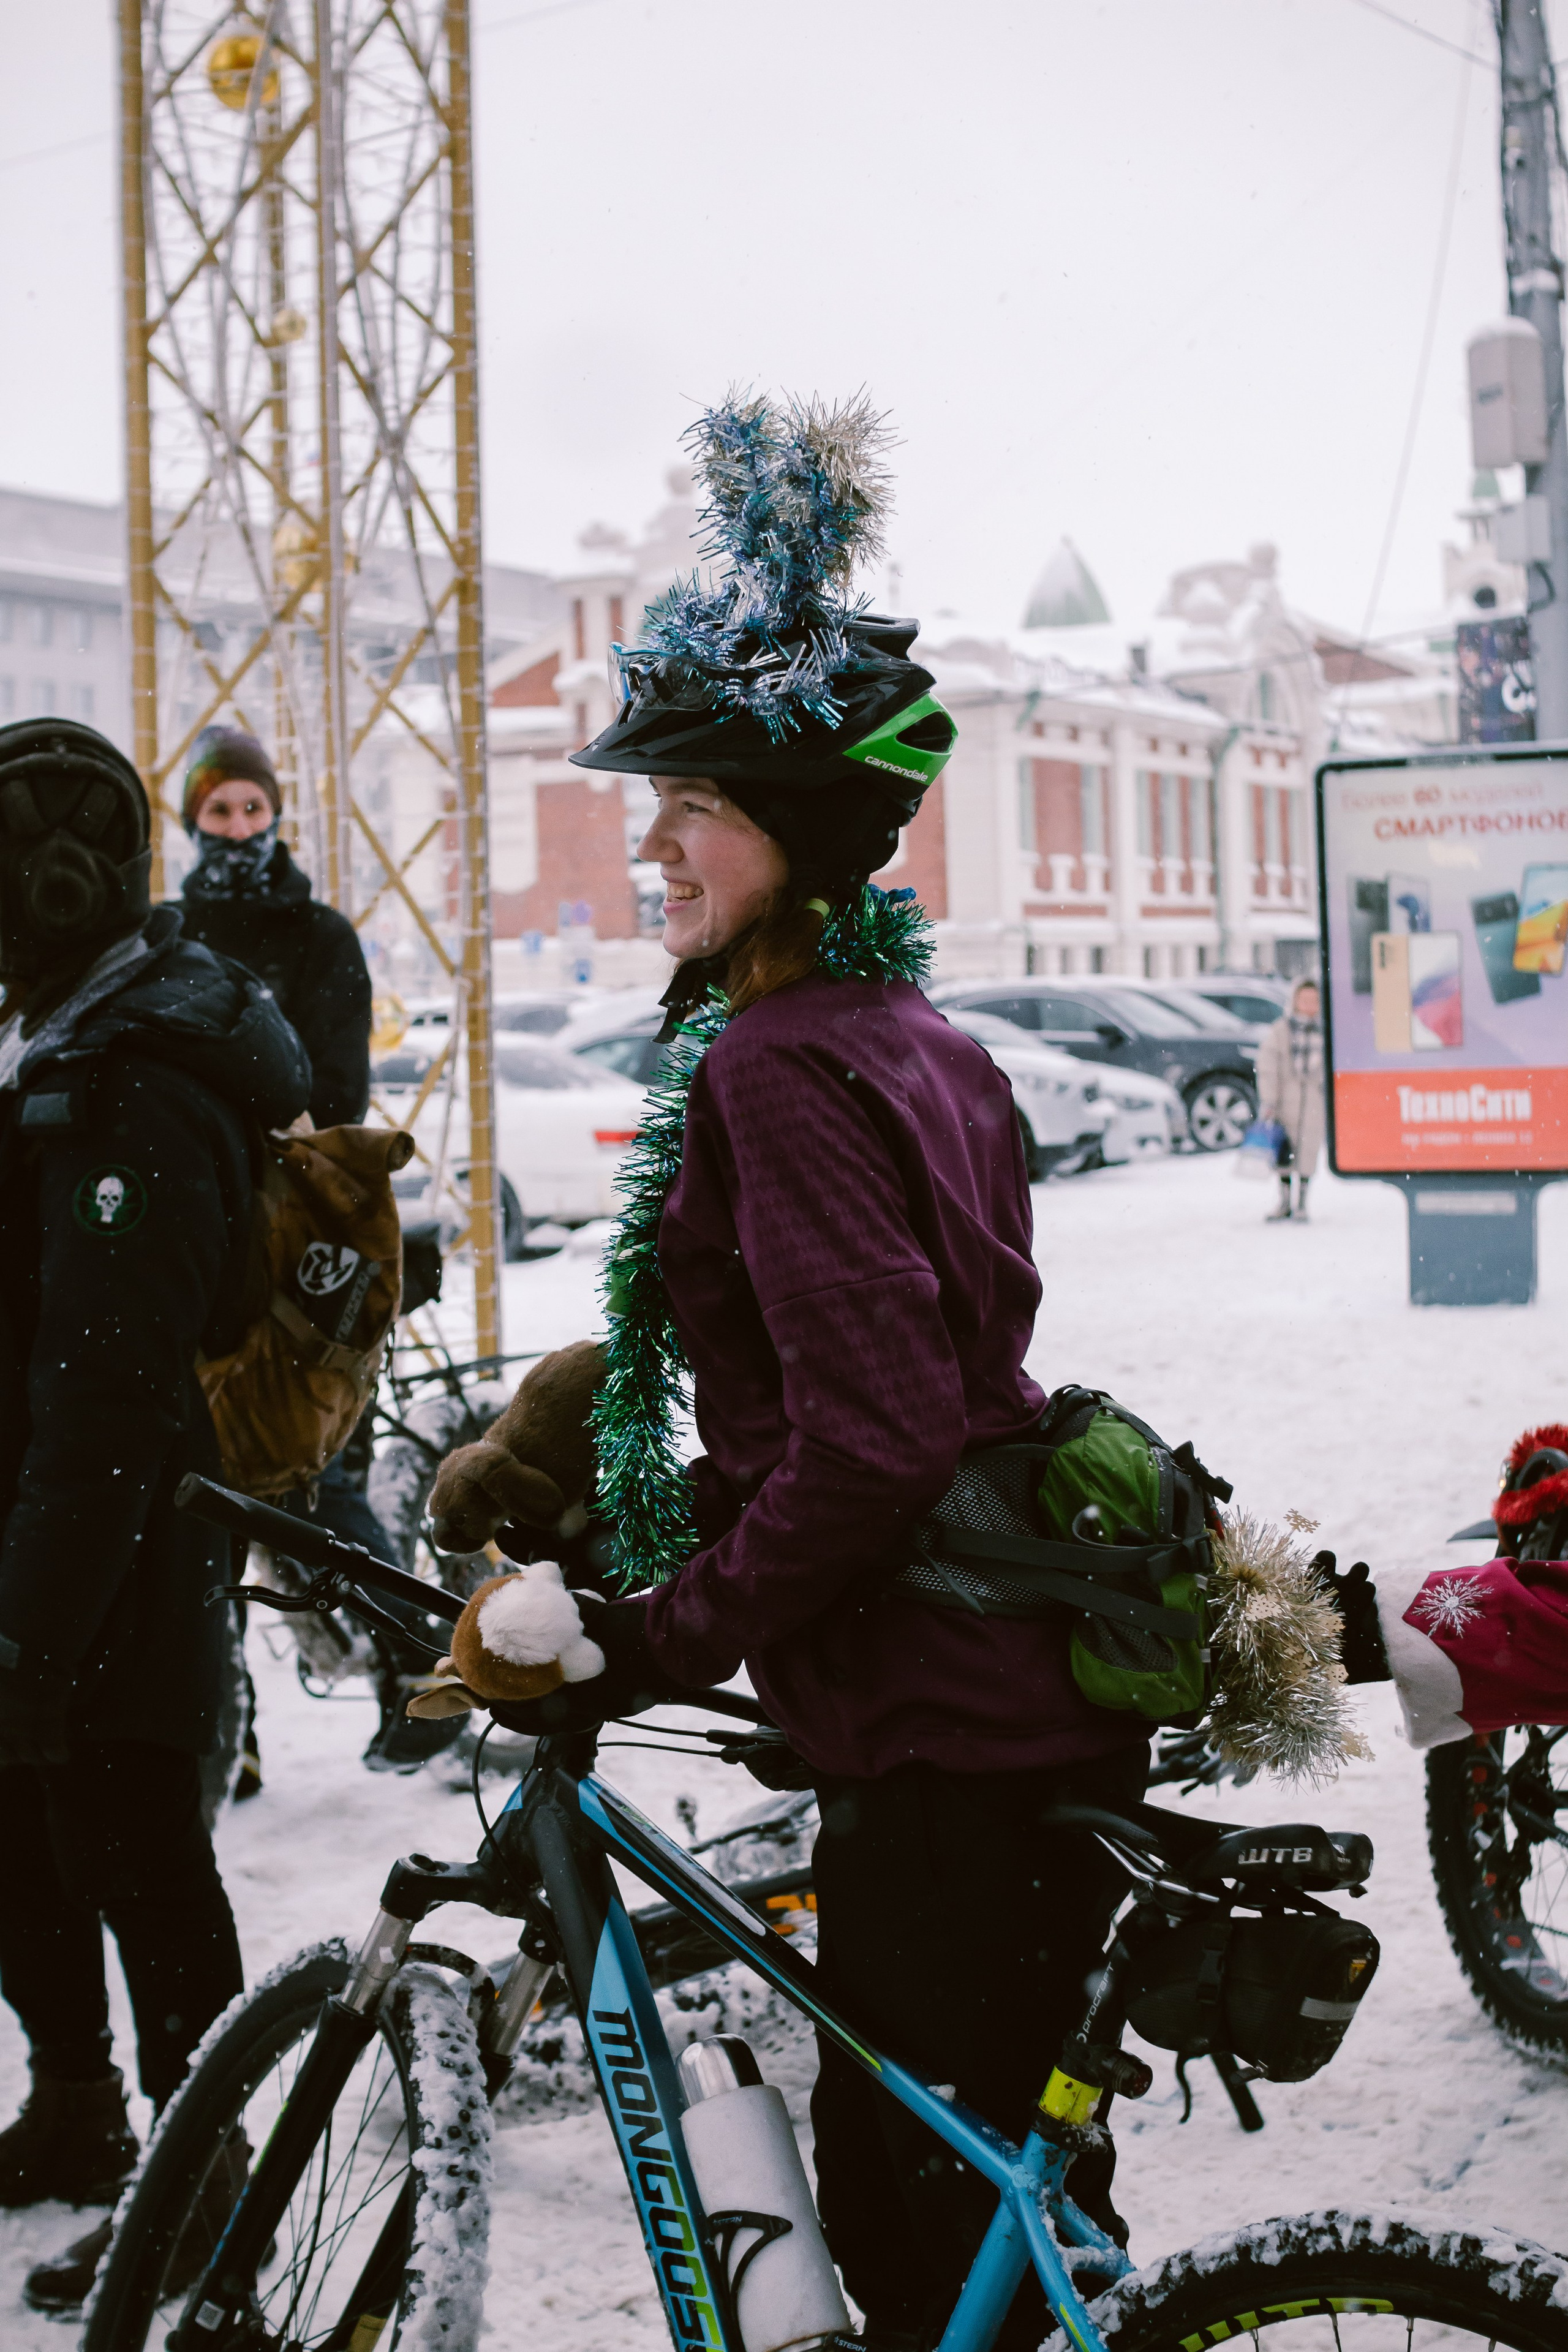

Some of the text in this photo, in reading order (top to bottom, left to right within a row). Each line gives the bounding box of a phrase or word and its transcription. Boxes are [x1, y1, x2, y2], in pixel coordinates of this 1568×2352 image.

[864, 756, 929, 782] cannondale
[1238, 1847, 1312, 1864] WTB
[592, 2005, 725, 2352] MONGOOS
[838, 2340, 867, 2352] STERN
